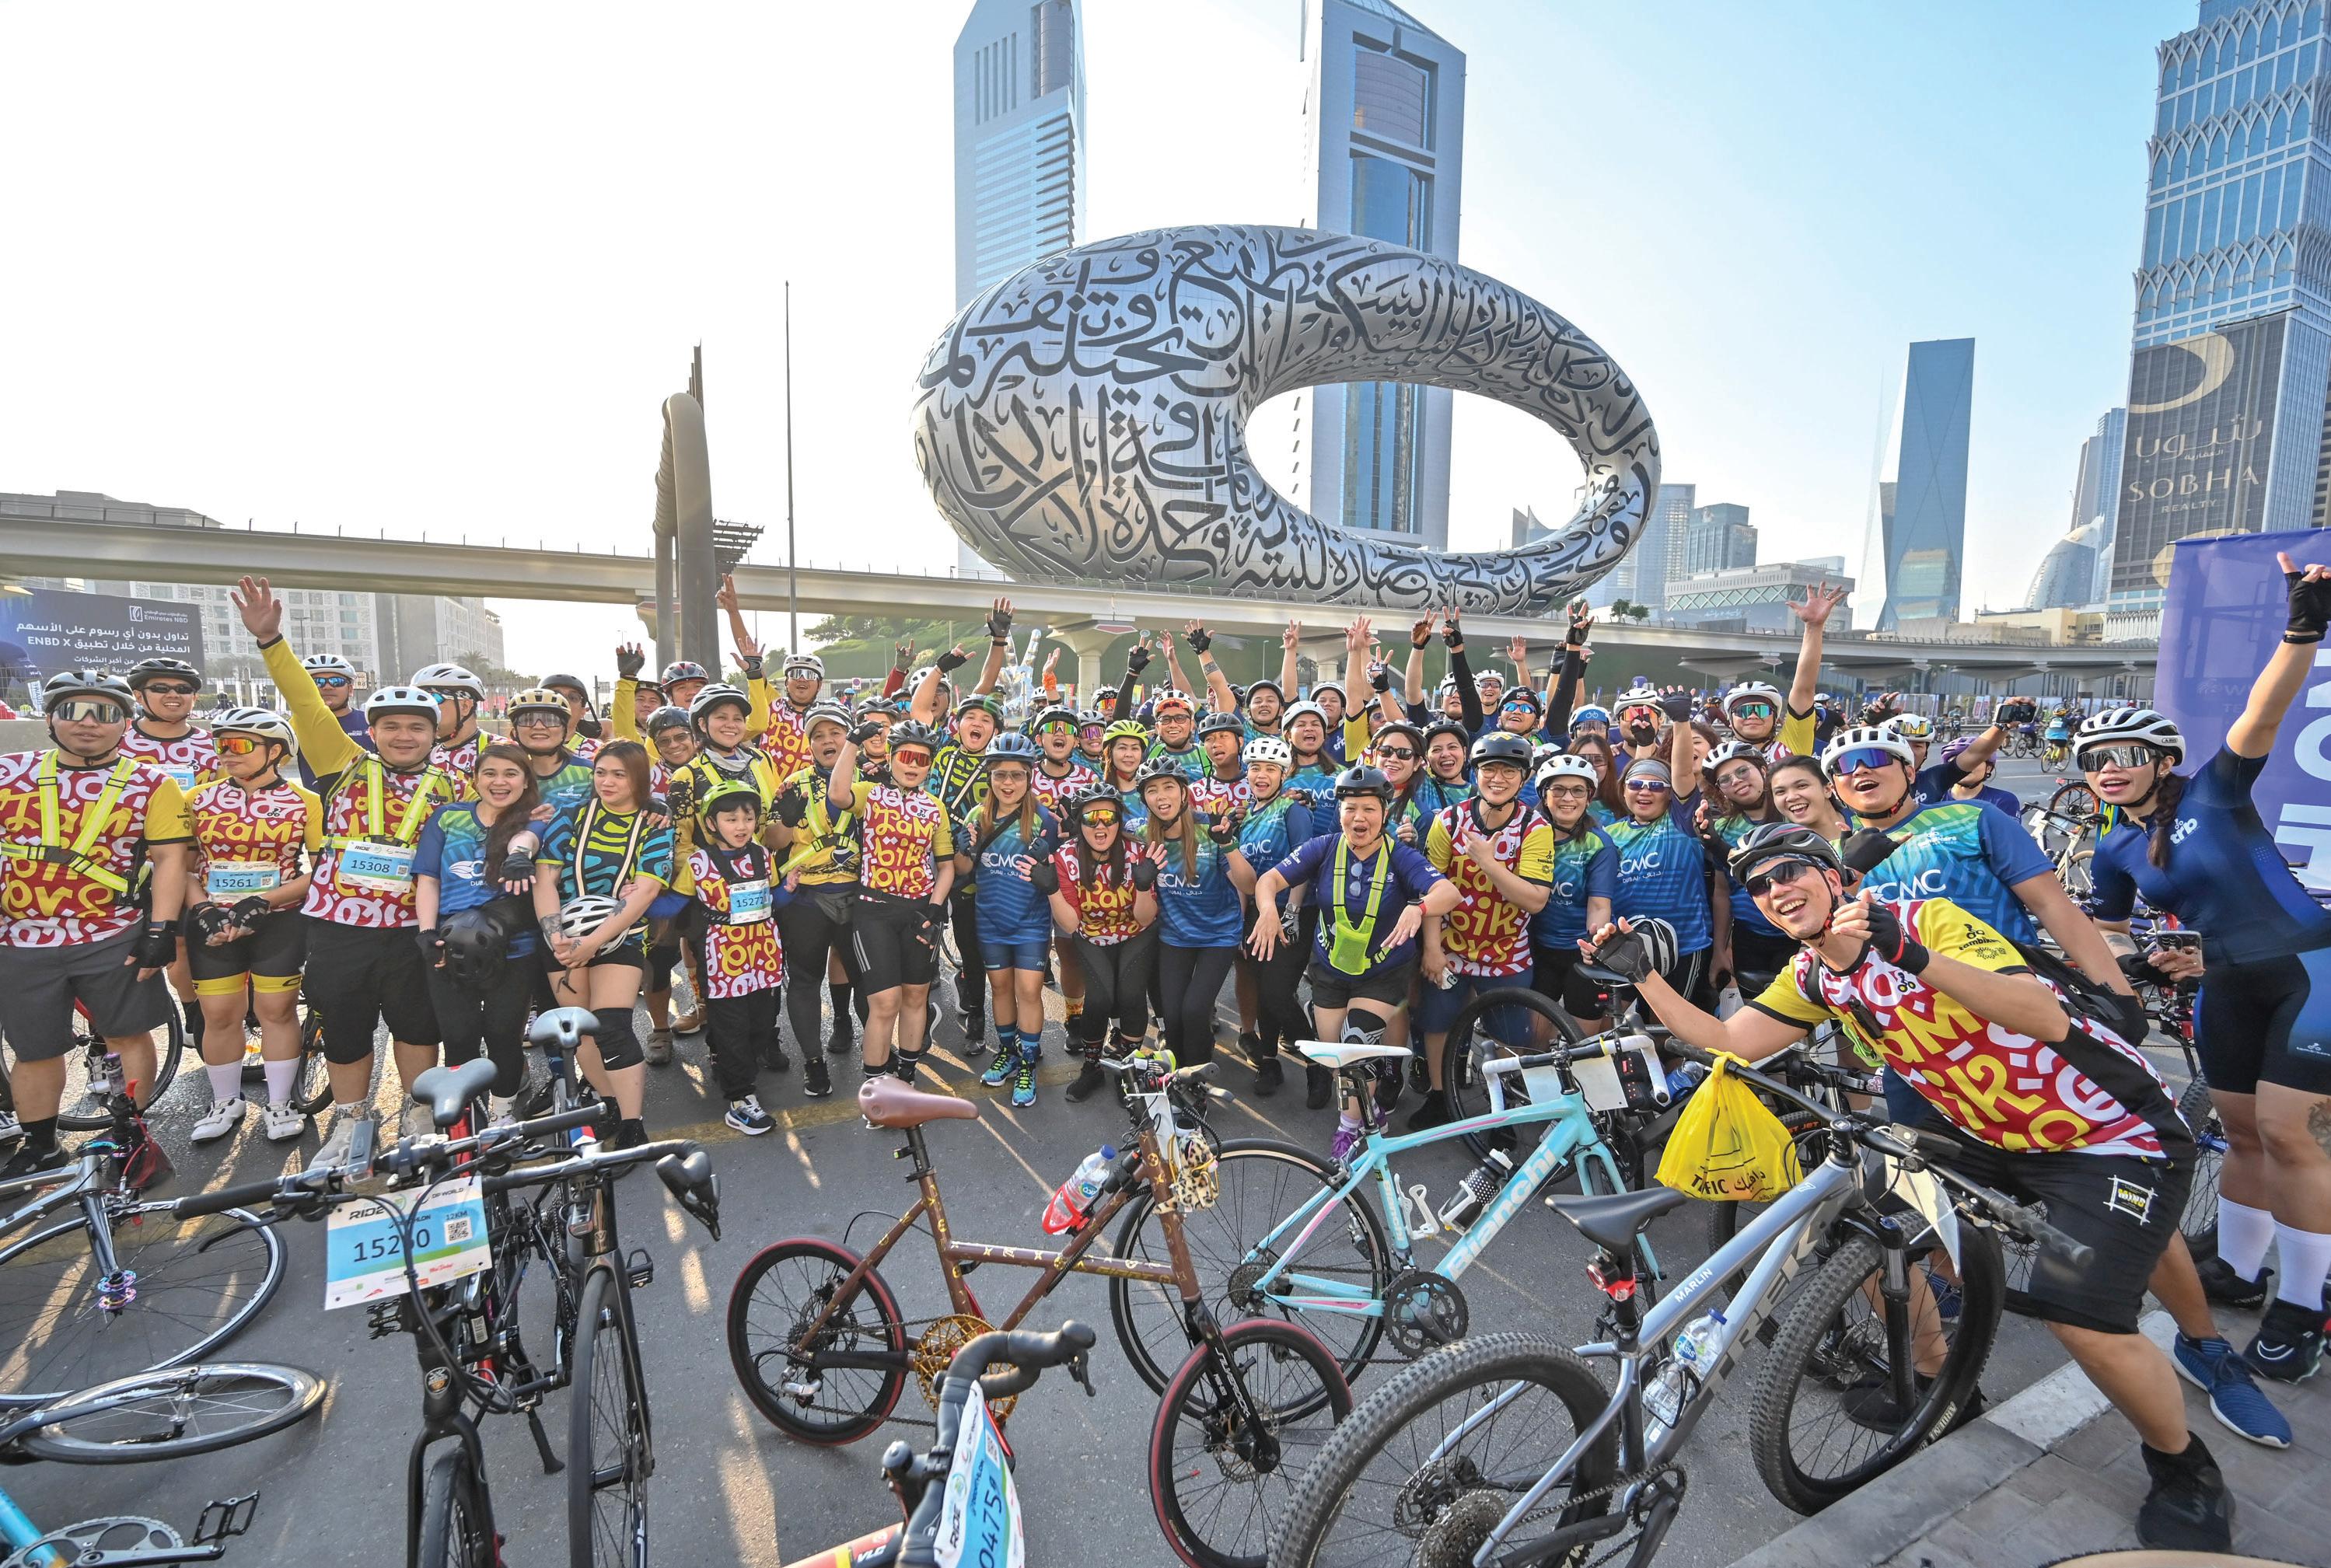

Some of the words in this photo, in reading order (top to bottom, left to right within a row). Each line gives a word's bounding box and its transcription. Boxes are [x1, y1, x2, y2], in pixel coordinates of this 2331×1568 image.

[2127, 466, 2260, 502] SOBHA
[2162, 499, 2217, 513] REALTY
[16, 623, 62, 633] الأسهم
[66, 625, 86, 634] على
[89, 629, 120, 638] رسوم
[122, 627, 135, 641] أي
[27, 636, 60, 646] ENBD
[138, 630, 160, 641] بدون
[163, 632, 189, 641] تداول
[75, 640, 108, 651] تطبيق
[112, 641, 135, 651] خلال
[138, 644, 152, 652] من
[155, 644, 190, 653] المحلية
[1246, 840, 1272, 856] CMC
[988, 852, 1023, 868] CMC
[1620, 851, 1661, 875] CMC
[351, 859, 390, 874] 15308
[215, 878, 253, 888] 15261
[1879, 868, 1947, 905] CMC
[442, 1187, 464, 1197] WORLD
[446, 1210, 467, 1221] 12KM
[1448, 1144, 1557, 1283] Bianchi
[353, 1228, 431, 1263] 1520
[1674, 1268, 1714, 1304] MARLIN
[1698, 1224, 1819, 1401] TREK
[949, 1503, 961, 1549] RIDE
